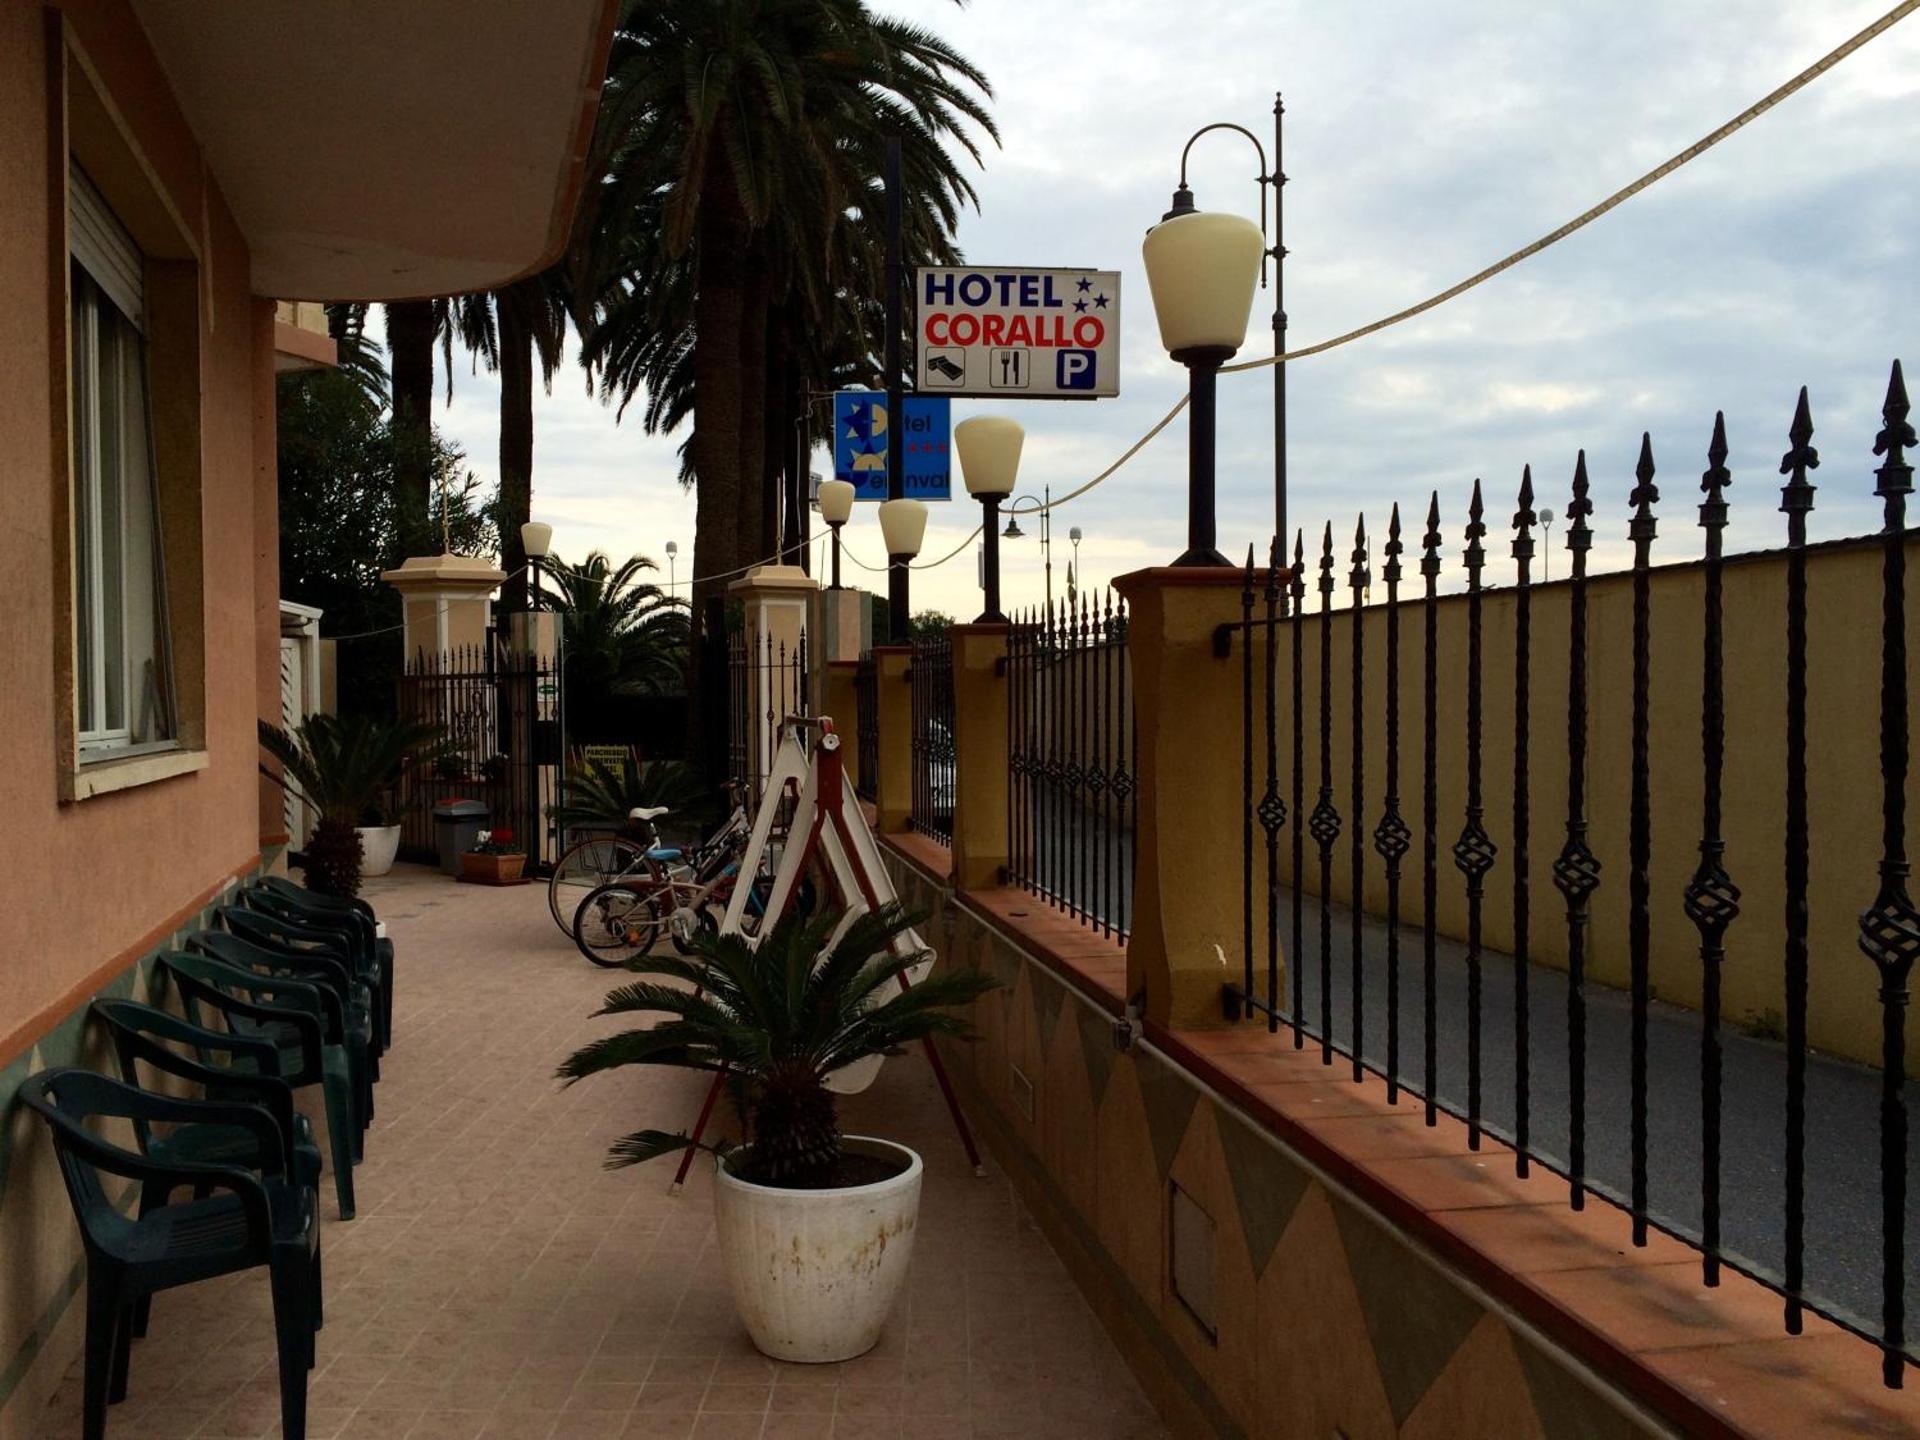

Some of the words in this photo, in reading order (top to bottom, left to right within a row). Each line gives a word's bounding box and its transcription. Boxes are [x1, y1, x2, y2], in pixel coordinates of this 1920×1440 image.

[926, 273, 1062, 307] HOTEL
[925, 313, 1104, 349] CORALLO
[1063, 353, 1089, 386] P
